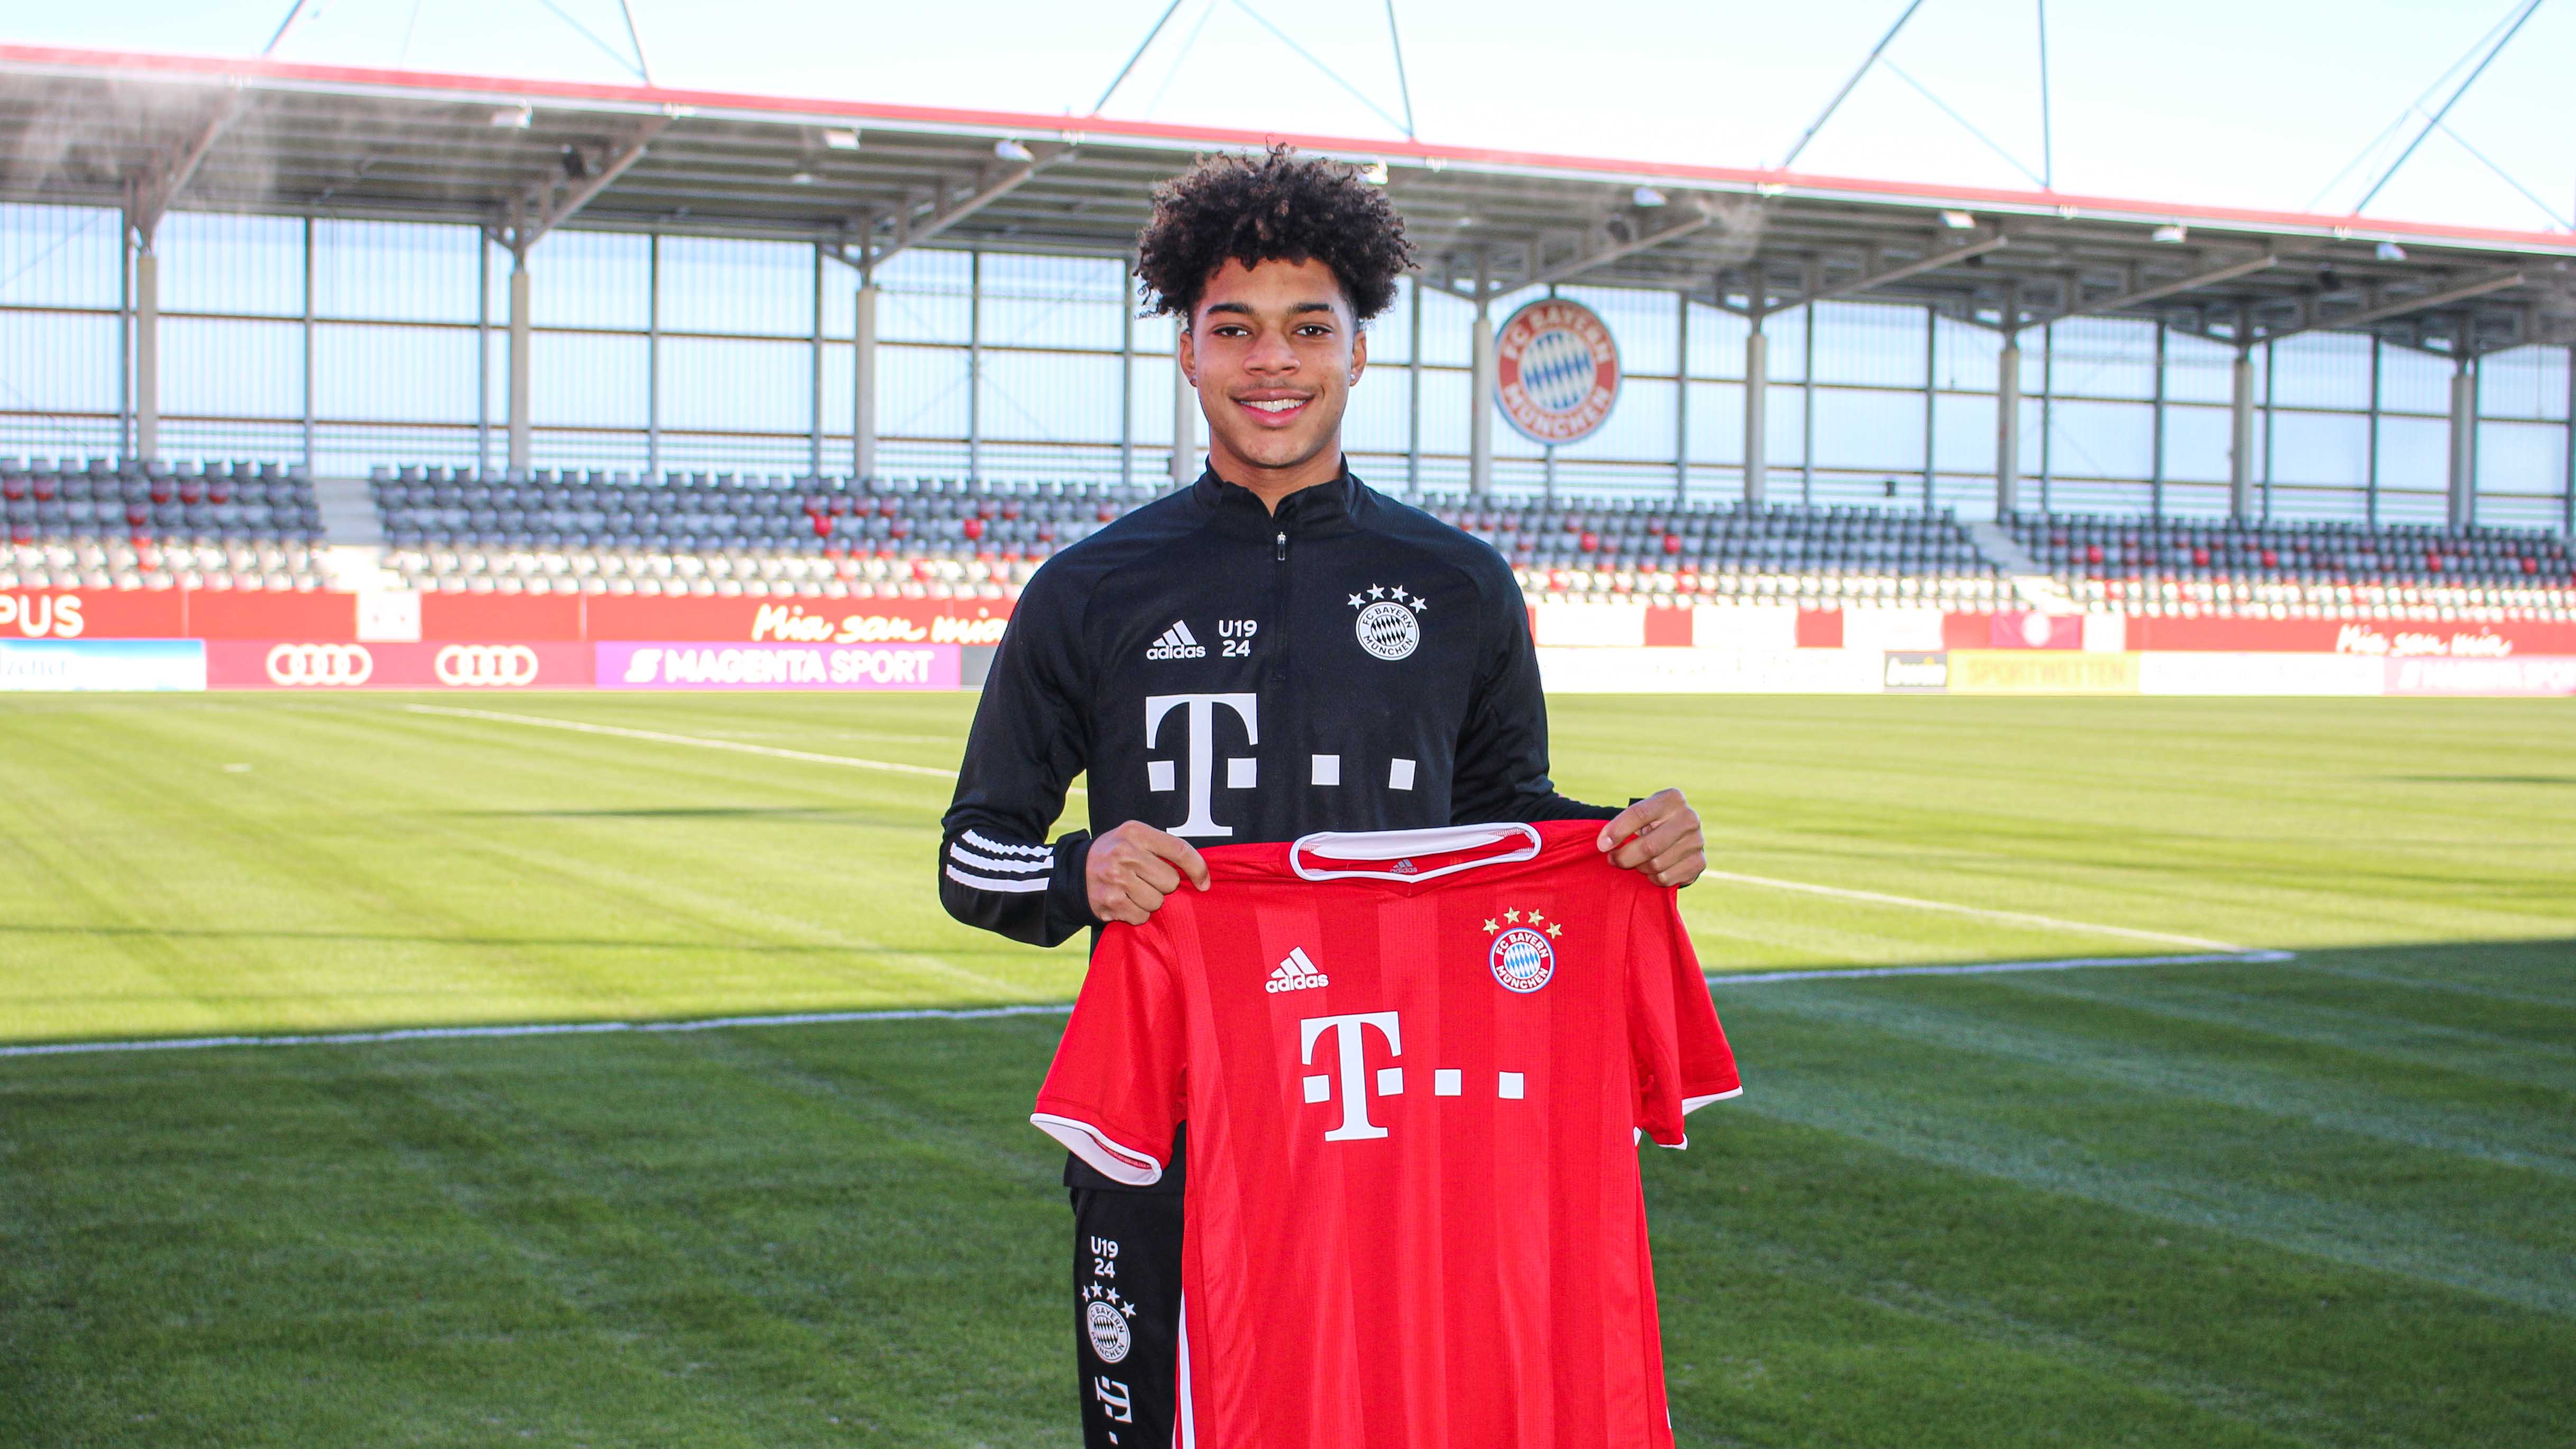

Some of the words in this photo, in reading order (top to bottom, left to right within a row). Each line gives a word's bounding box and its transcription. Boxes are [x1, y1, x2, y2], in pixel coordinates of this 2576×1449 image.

[751, 603, 834, 641] Mia
[833, 615, 927, 644] san
[1218, 620, 1258, 638] U19
[1363, 613, 1374, 625] FC
[1375, 607, 1413, 628] BAYERN
[1146, 644, 1206, 660] adidas
[1222, 640, 1250, 657] 24
[665, 649, 826, 684] MAGENTA
[830, 649, 934, 684] SPORT
[1146, 693, 1258, 836] T
[1496, 940, 1508, 955] FC
[1508, 933, 1549, 958] BAYERN
[1265, 973, 1329, 994] adidas
[1301, 1011, 1402, 1142] T
[1091, 1235, 1118, 1258] U19
[1094, 1258, 1116, 1278] 24
[1096, 1307, 1125, 1332] BAYERN
